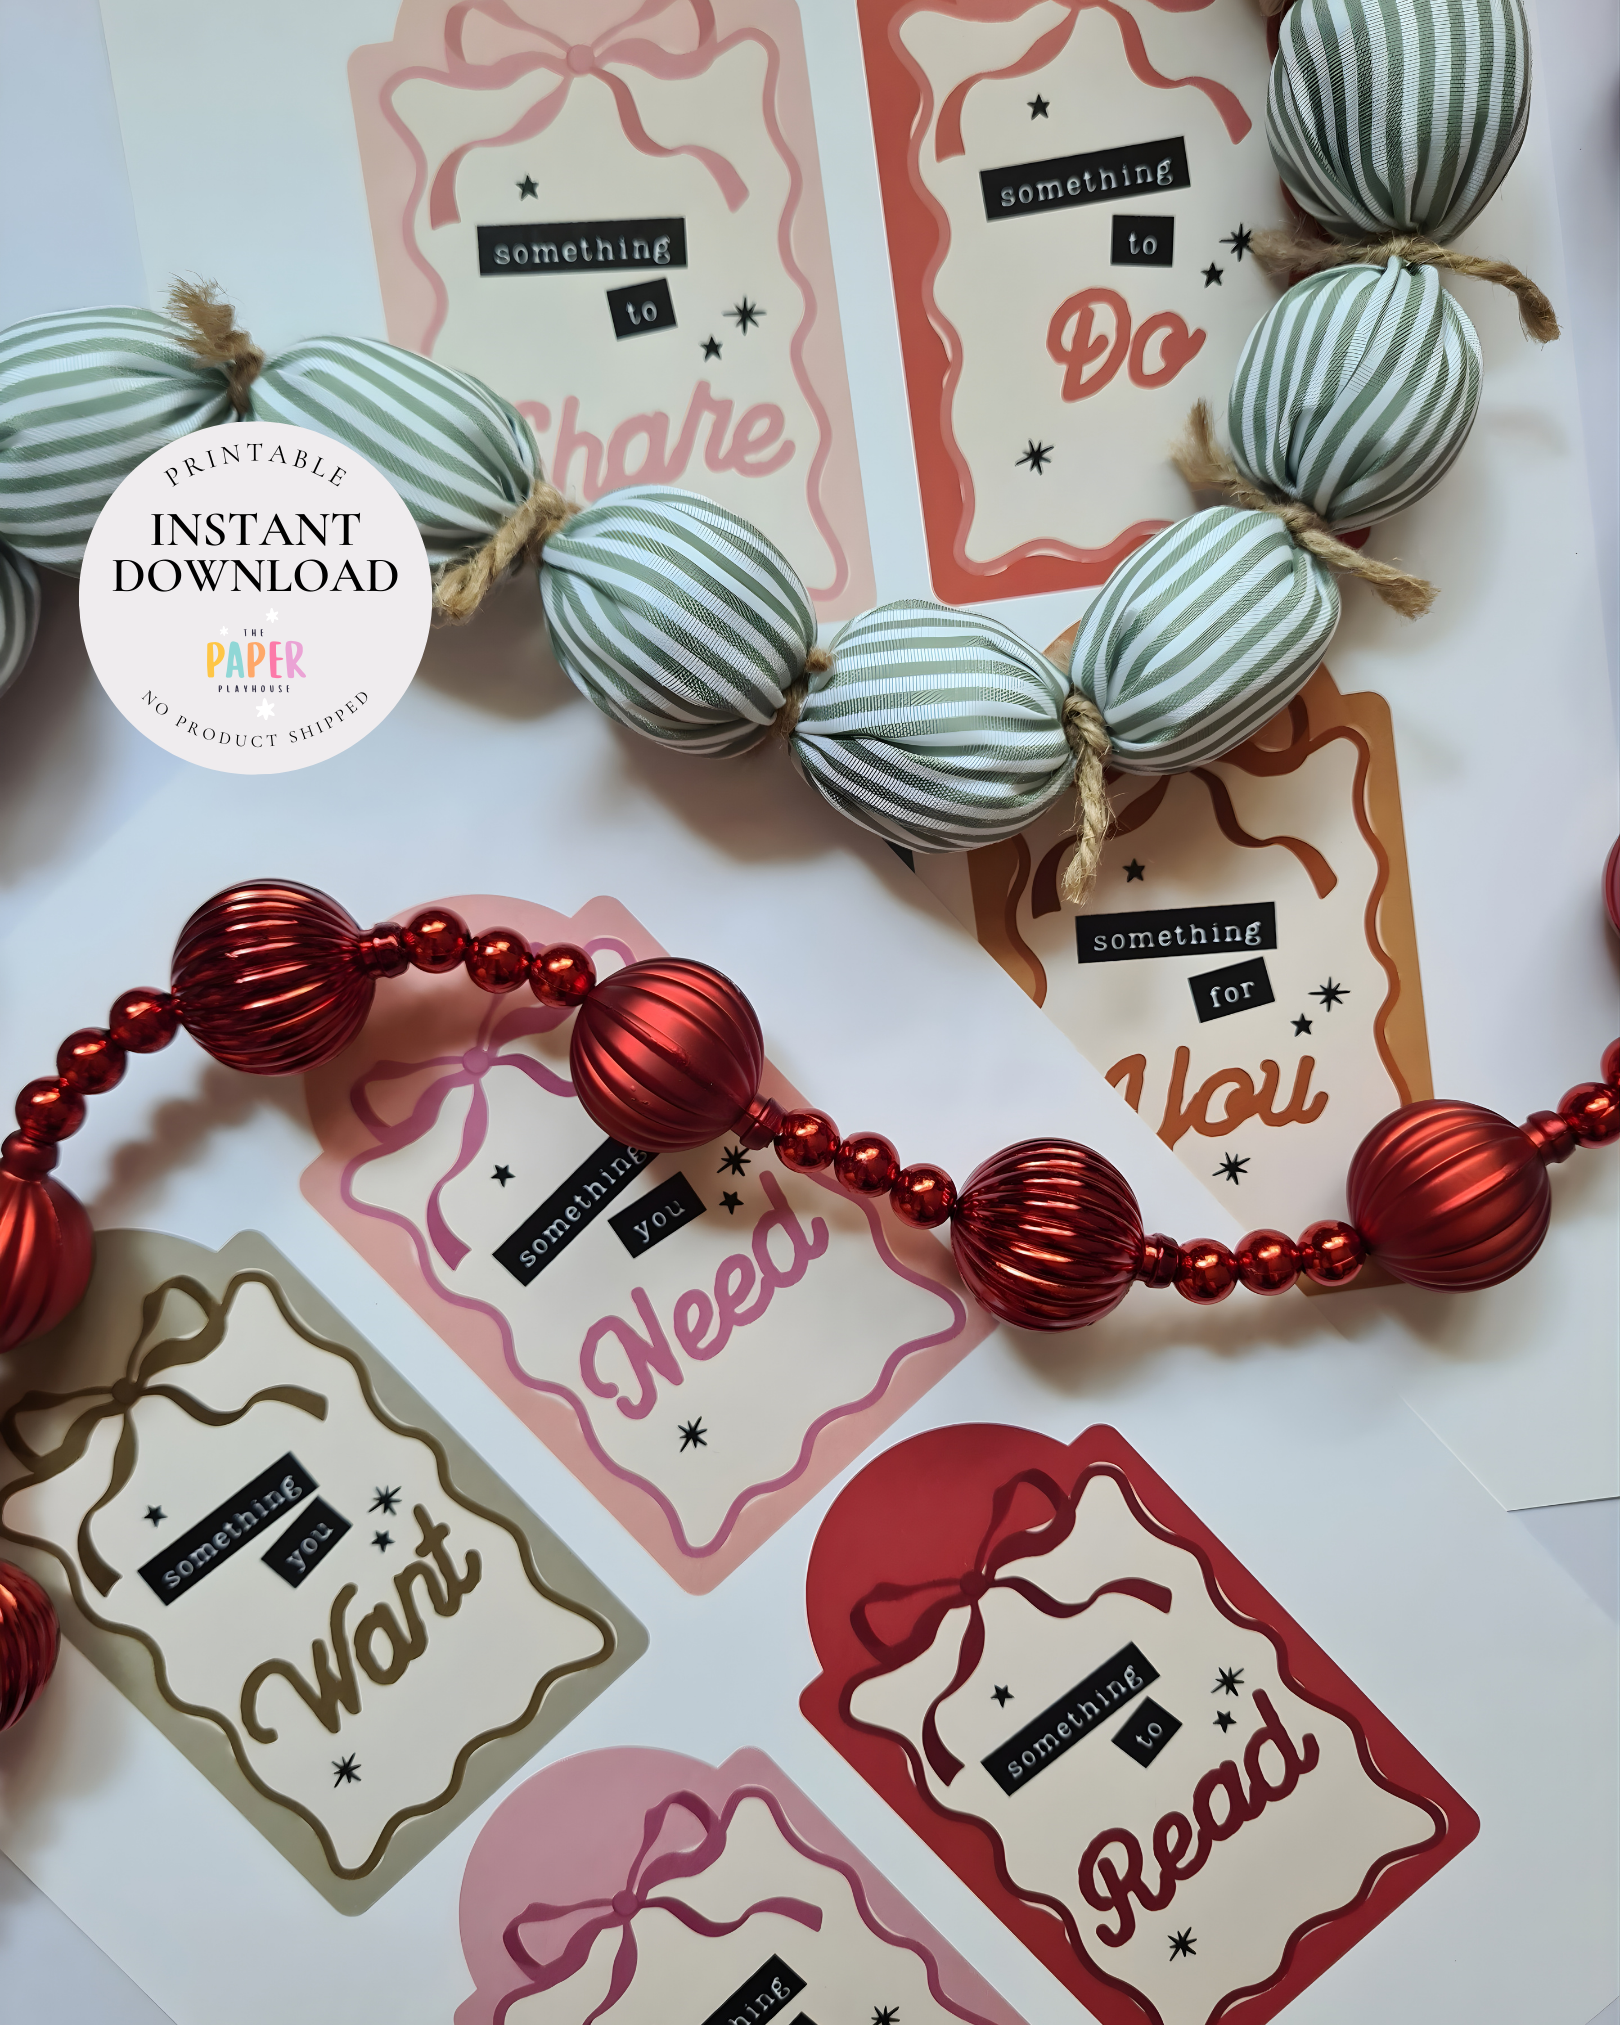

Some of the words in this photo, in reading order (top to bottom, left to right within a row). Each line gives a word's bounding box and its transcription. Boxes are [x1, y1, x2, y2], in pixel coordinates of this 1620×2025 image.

[1000, 157, 1174, 208] something
[493, 234, 671, 266] something
[1128, 231, 1158, 256] to
[625, 300, 658, 326] to
[1045, 286, 1208, 404] Do
[1093, 921, 1262, 951] something
[1209, 980, 1255, 1008] for
[632, 1199, 686, 1244] you
[579, 1170, 830, 1420] Need
[161, 1474, 303, 1590] something
[284, 1520, 334, 1574] you
[240, 1503, 483, 1745] Want
[1007, 1664, 1144, 1780] something
[1135, 1721, 1164, 1749] to
[1077, 1688, 1320, 1948] Read
